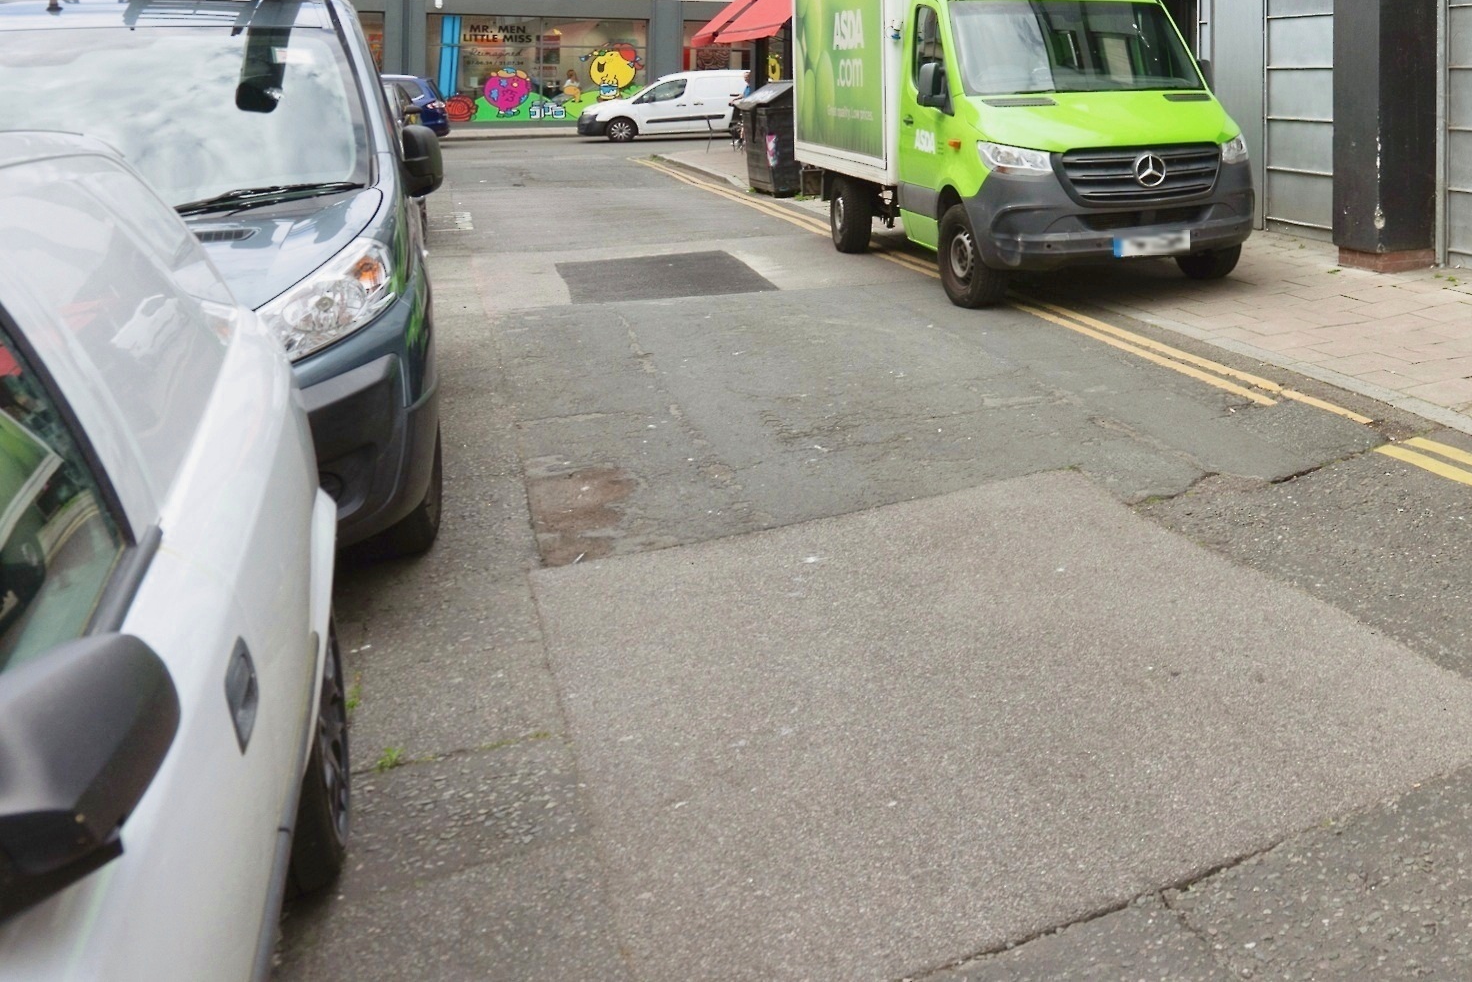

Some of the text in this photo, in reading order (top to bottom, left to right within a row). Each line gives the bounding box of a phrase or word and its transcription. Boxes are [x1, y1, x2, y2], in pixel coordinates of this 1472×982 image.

[463, 34, 532, 43] LITTLE MISS
[469, 24, 526, 34] MR. MEN
[833, 8, 864, 50] ASDA
[837, 58, 863, 87] .com
[914, 128, 936, 155] ASDA
